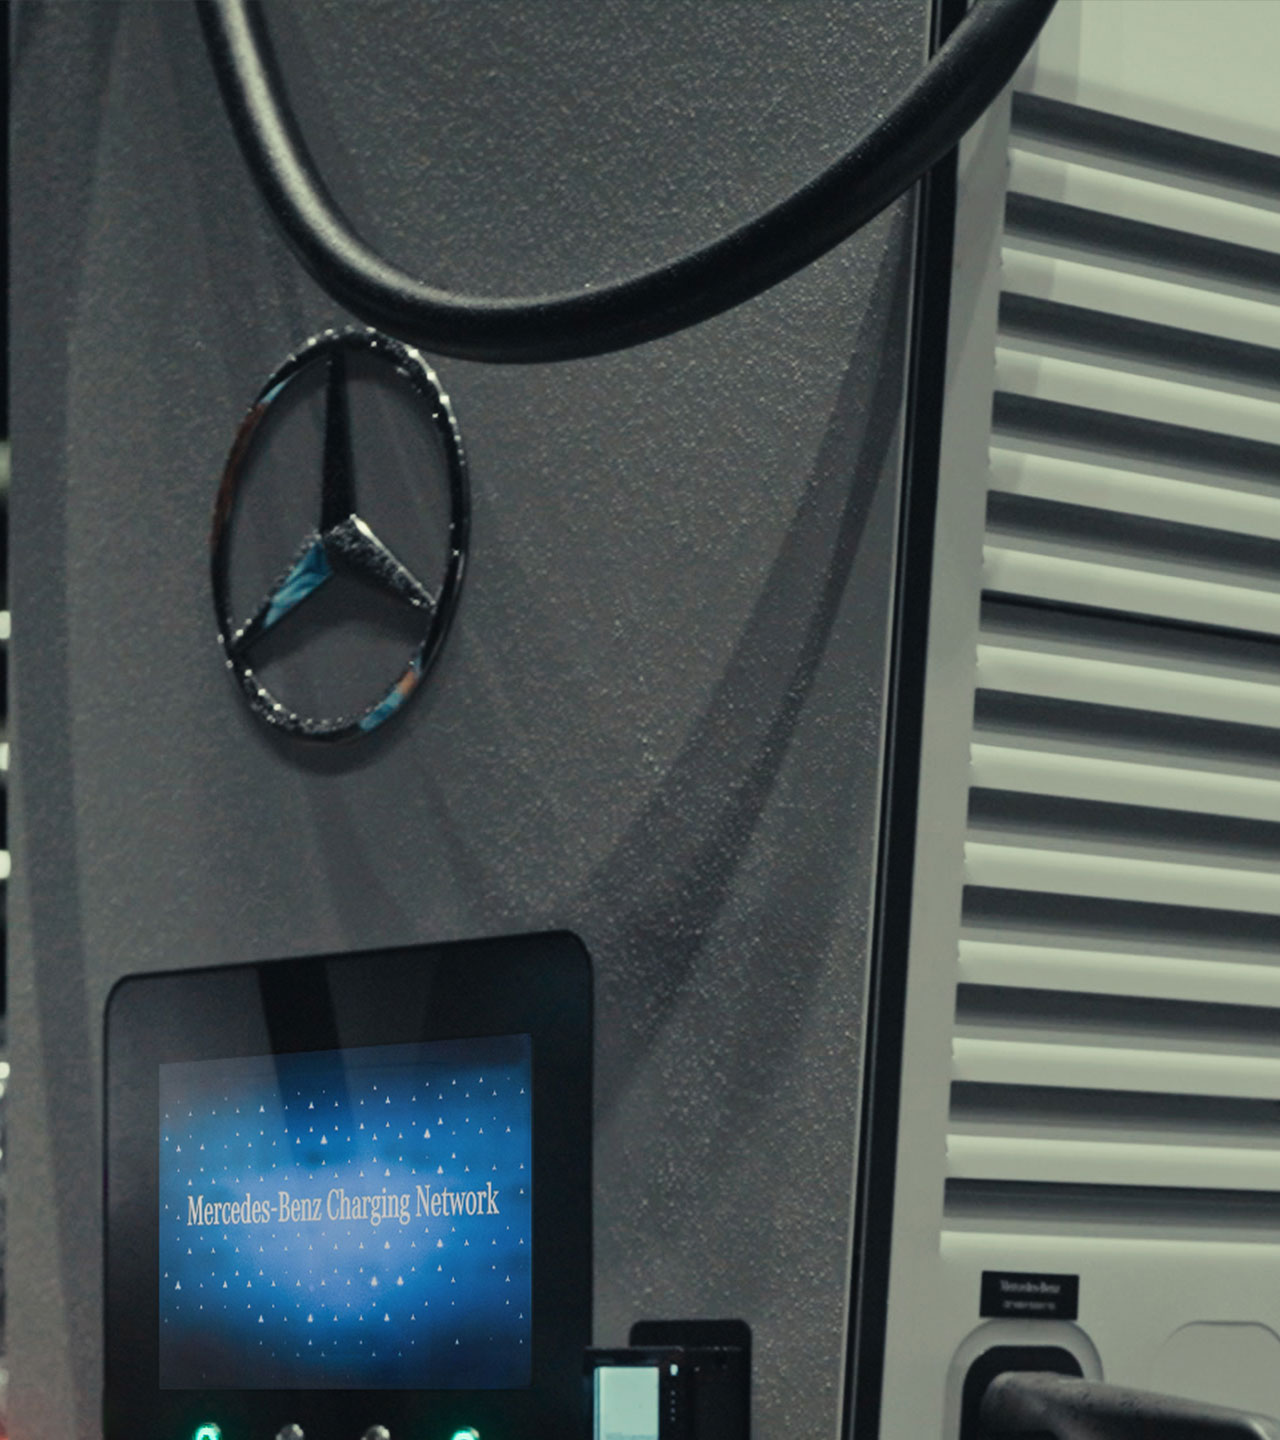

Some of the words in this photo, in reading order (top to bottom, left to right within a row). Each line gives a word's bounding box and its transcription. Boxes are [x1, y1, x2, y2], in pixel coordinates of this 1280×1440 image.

[187, 1191, 322, 1226] Mercedes-Benz
[327, 1186, 411, 1227] Charging
[415, 1181, 500, 1217] Network
